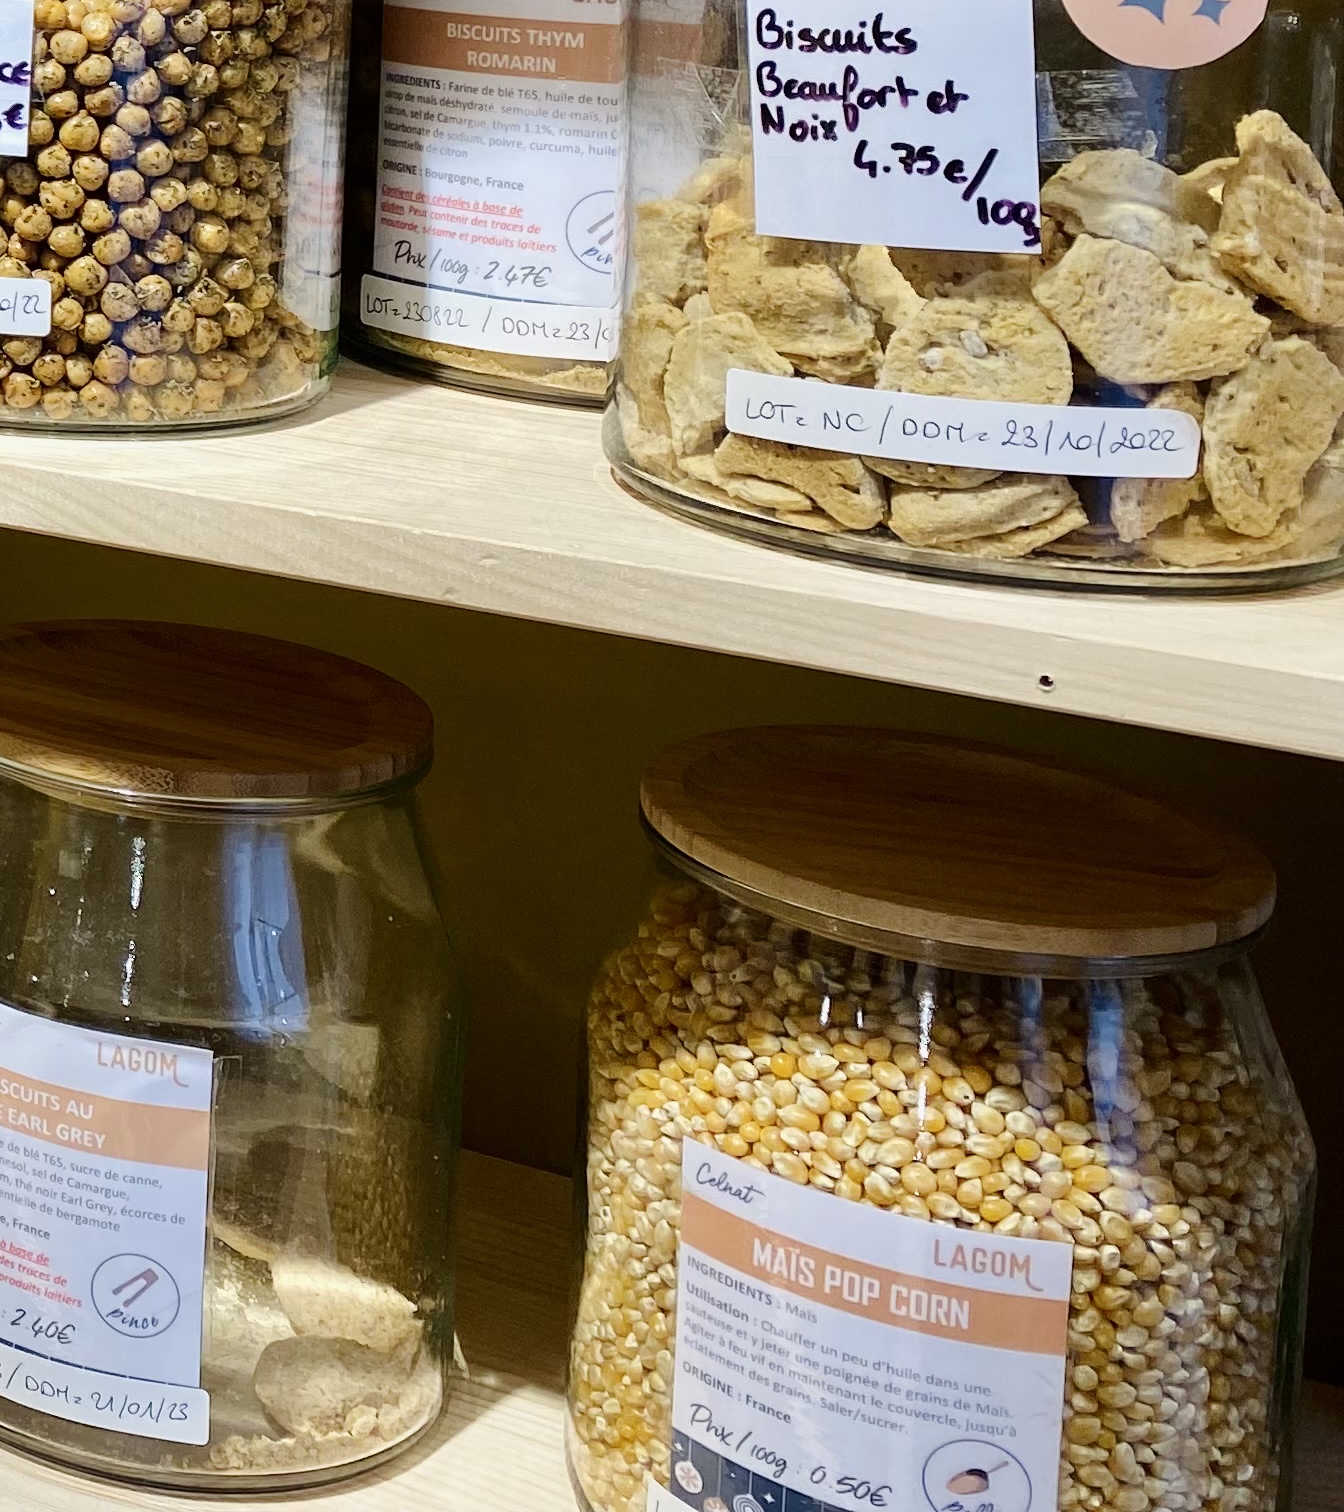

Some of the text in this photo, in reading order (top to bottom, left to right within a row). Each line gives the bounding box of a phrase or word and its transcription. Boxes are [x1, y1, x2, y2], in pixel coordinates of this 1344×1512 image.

[447, 23, 584, 49] BISCUITS THYM
[756, 8, 918, 55] Biscuits
[467, 51, 556, 73] ROMARIN
[756, 61, 970, 133] Beaufort et
[760, 103, 839, 142] Noix
[383, 159, 524, 191] ORIGINE Bourgogne, France
[976, 197, 1041, 247] 100g
[483, 261, 552, 288] 2.47€
[97, 1042, 189, 1087] LAGOM
[8, 1108, 50, 1135] EARL
[55, 1124, 106, 1148] GREY
[65, 1099, 93, 1120] AU
[13, 1220, 50, 1239] France
[752, 1237, 970, 1330] MAÏS POP CORN
[932, 1238, 1043, 1292] LAGOM
[687, 1256, 818, 1324] INGREDIENTS Maïs
[10, 1308, 76, 1345] 2.40€
[685, 1280, 991, 1397] Utilisation Chauffer un peu d'huile dans une
[682, 1360, 791, 1425] ORIGINE France
[809, 1458, 892, 1509] 0.50€
